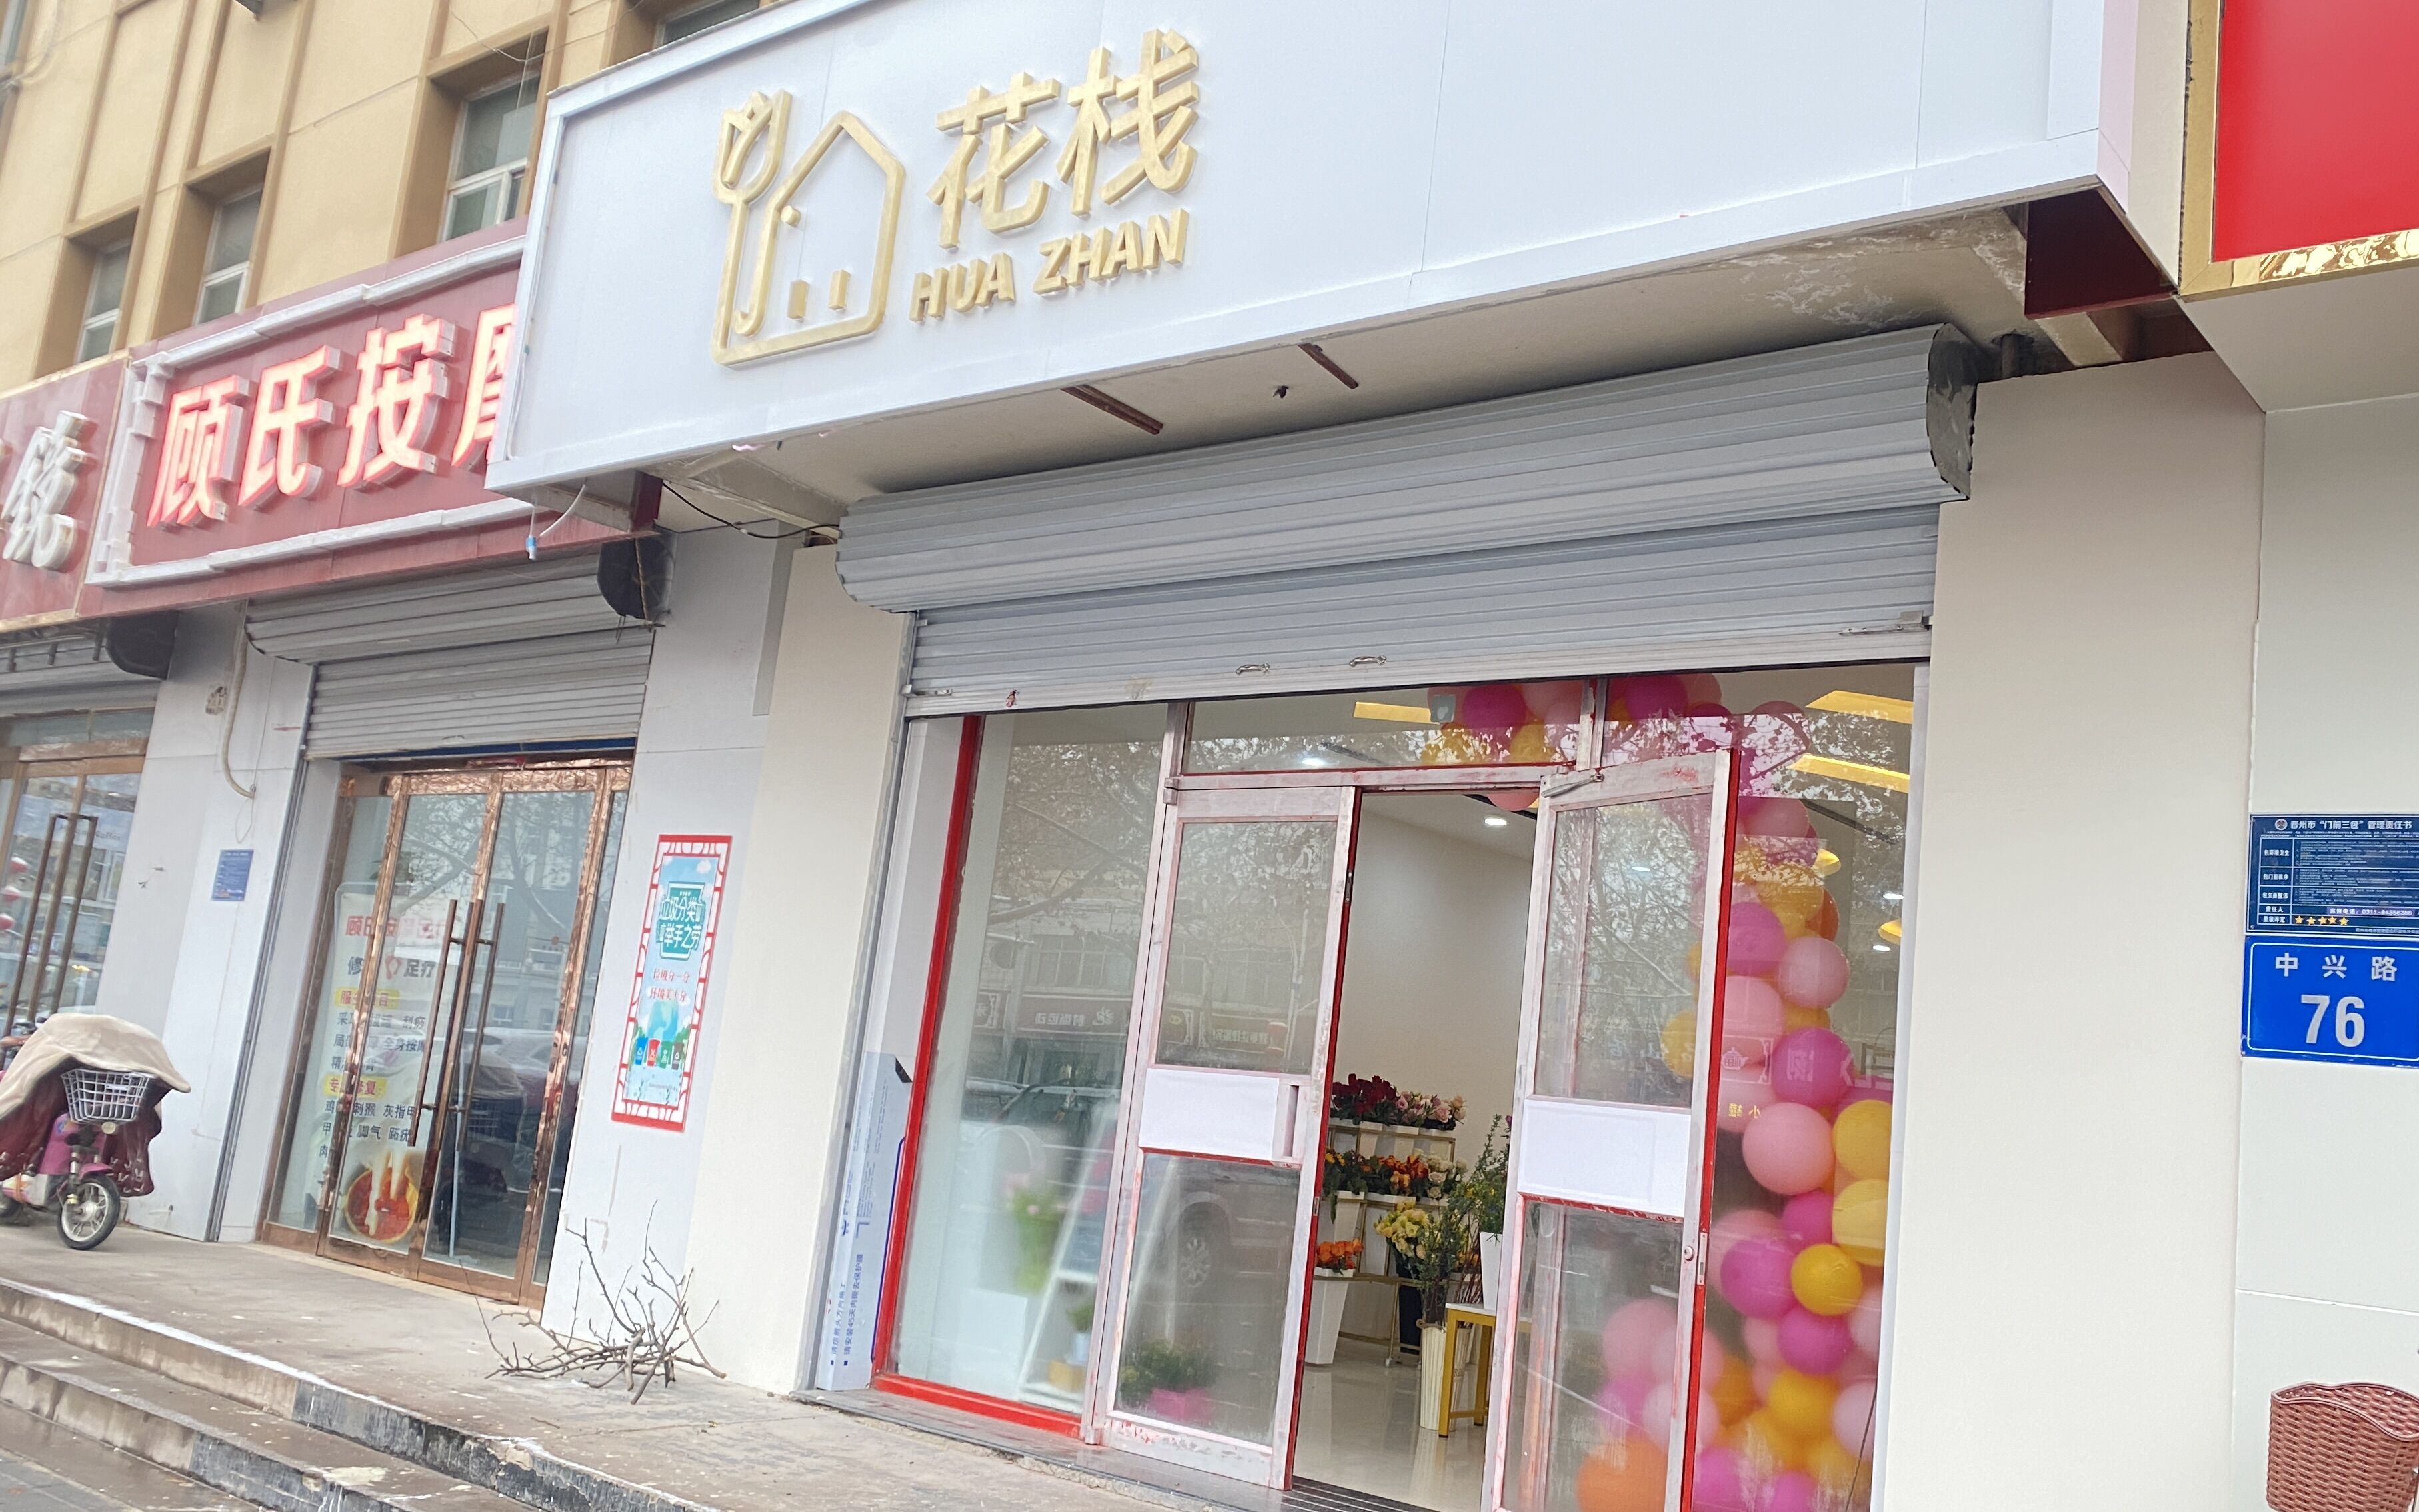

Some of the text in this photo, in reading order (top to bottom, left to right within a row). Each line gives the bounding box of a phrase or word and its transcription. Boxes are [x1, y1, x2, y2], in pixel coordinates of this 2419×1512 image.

[927, 28, 1199, 249] 花栈
[909, 208, 1190, 323] HUA ZHAN
[2275, 953, 2398, 982] 中兴路
[2300, 993, 2365, 1047] 76
[357, 1124, 381, 1141] 脚气
